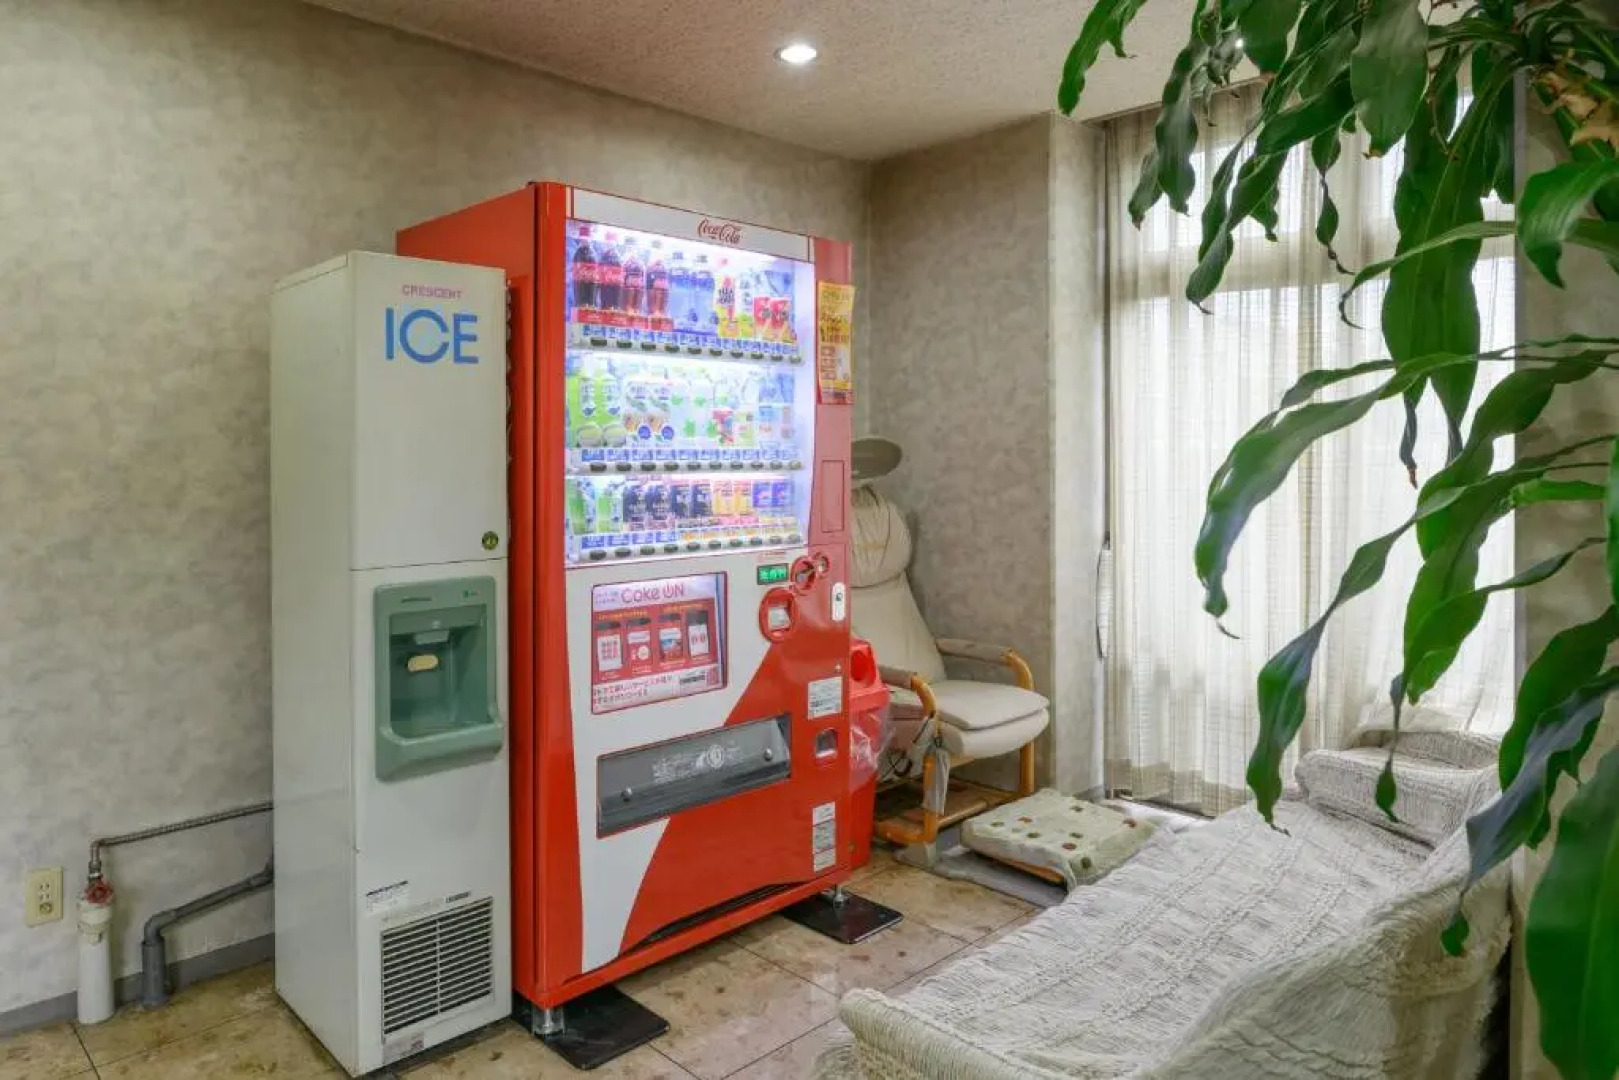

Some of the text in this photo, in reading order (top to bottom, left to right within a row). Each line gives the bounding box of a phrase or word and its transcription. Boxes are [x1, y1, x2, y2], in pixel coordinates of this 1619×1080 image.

[402, 285, 462, 299] CRESCENT
[385, 307, 479, 364] ICE
[621, 587, 660, 603] Coke
